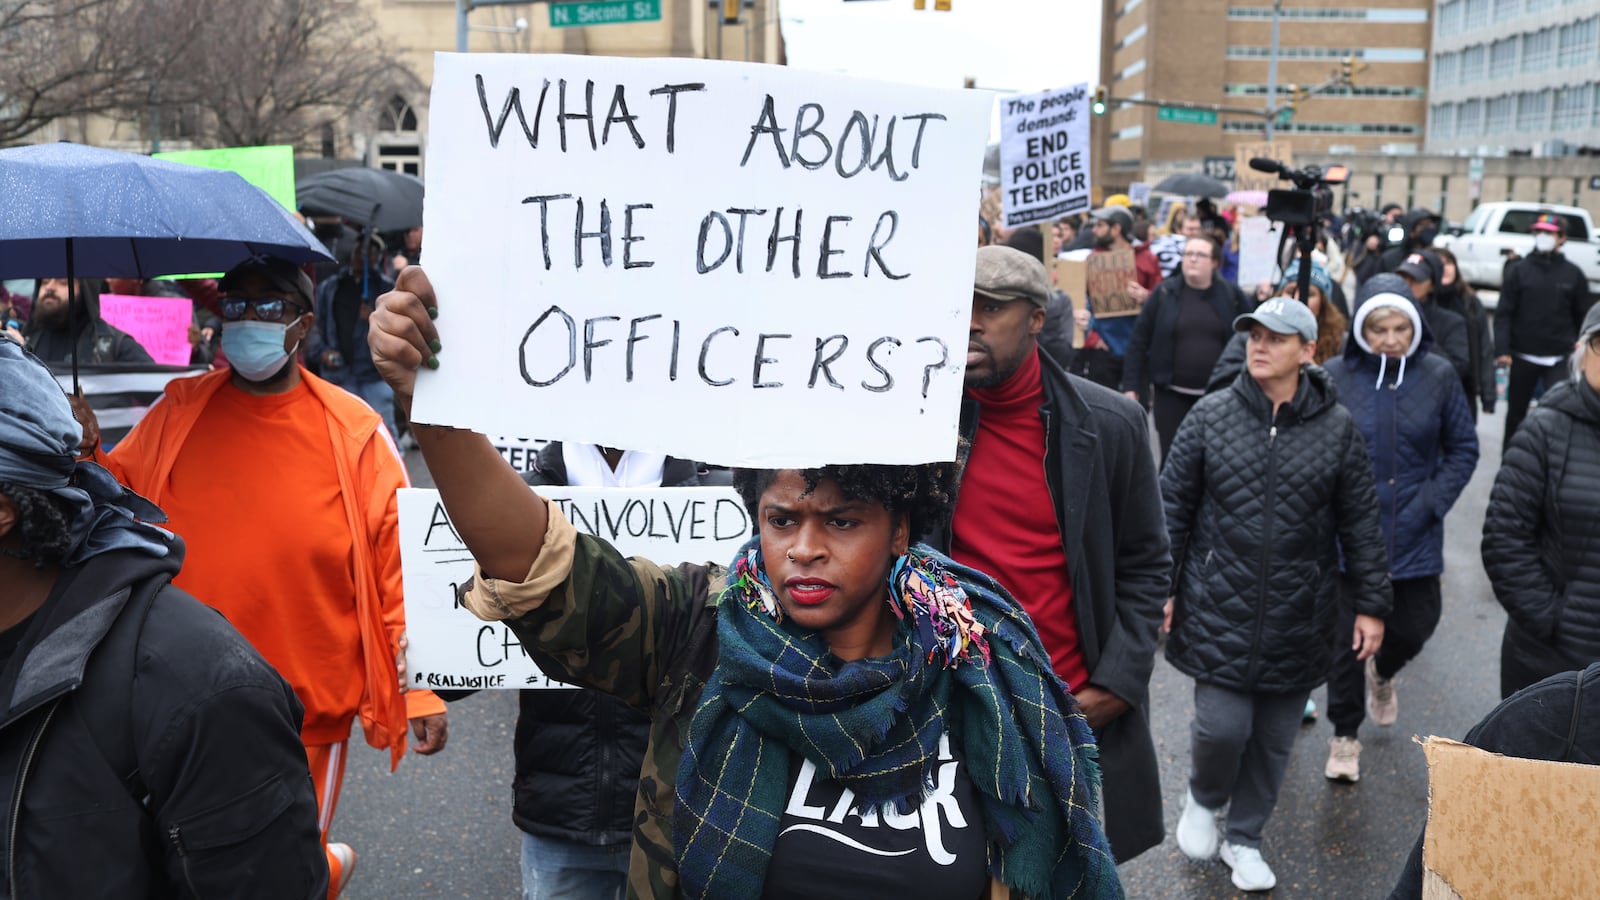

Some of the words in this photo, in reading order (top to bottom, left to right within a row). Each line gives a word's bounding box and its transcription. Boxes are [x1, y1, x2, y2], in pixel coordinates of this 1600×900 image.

[553, 6, 570, 23] N.
[577, 4, 627, 22] Second
[633, 2, 656, 19] St.
[1008, 99, 1035, 115] The
[1039, 88, 1085, 113] people
[475, 74, 706, 154] WHAT
[740, 94, 947, 181] ABOUT
[1017, 108, 1077, 133] demand:
[1027, 130, 1068, 158] END
[1013, 151, 1081, 185] POLICE
[1009, 173, 1086, 207] TERROR
[522, 194, 654, 270] THE
[696, 205, 910, 279] OTHER
[519, 305, 948, 415] OFFICERS?
[495, 447, 539, 471] TER
[477, 625, 526, 668] CH
